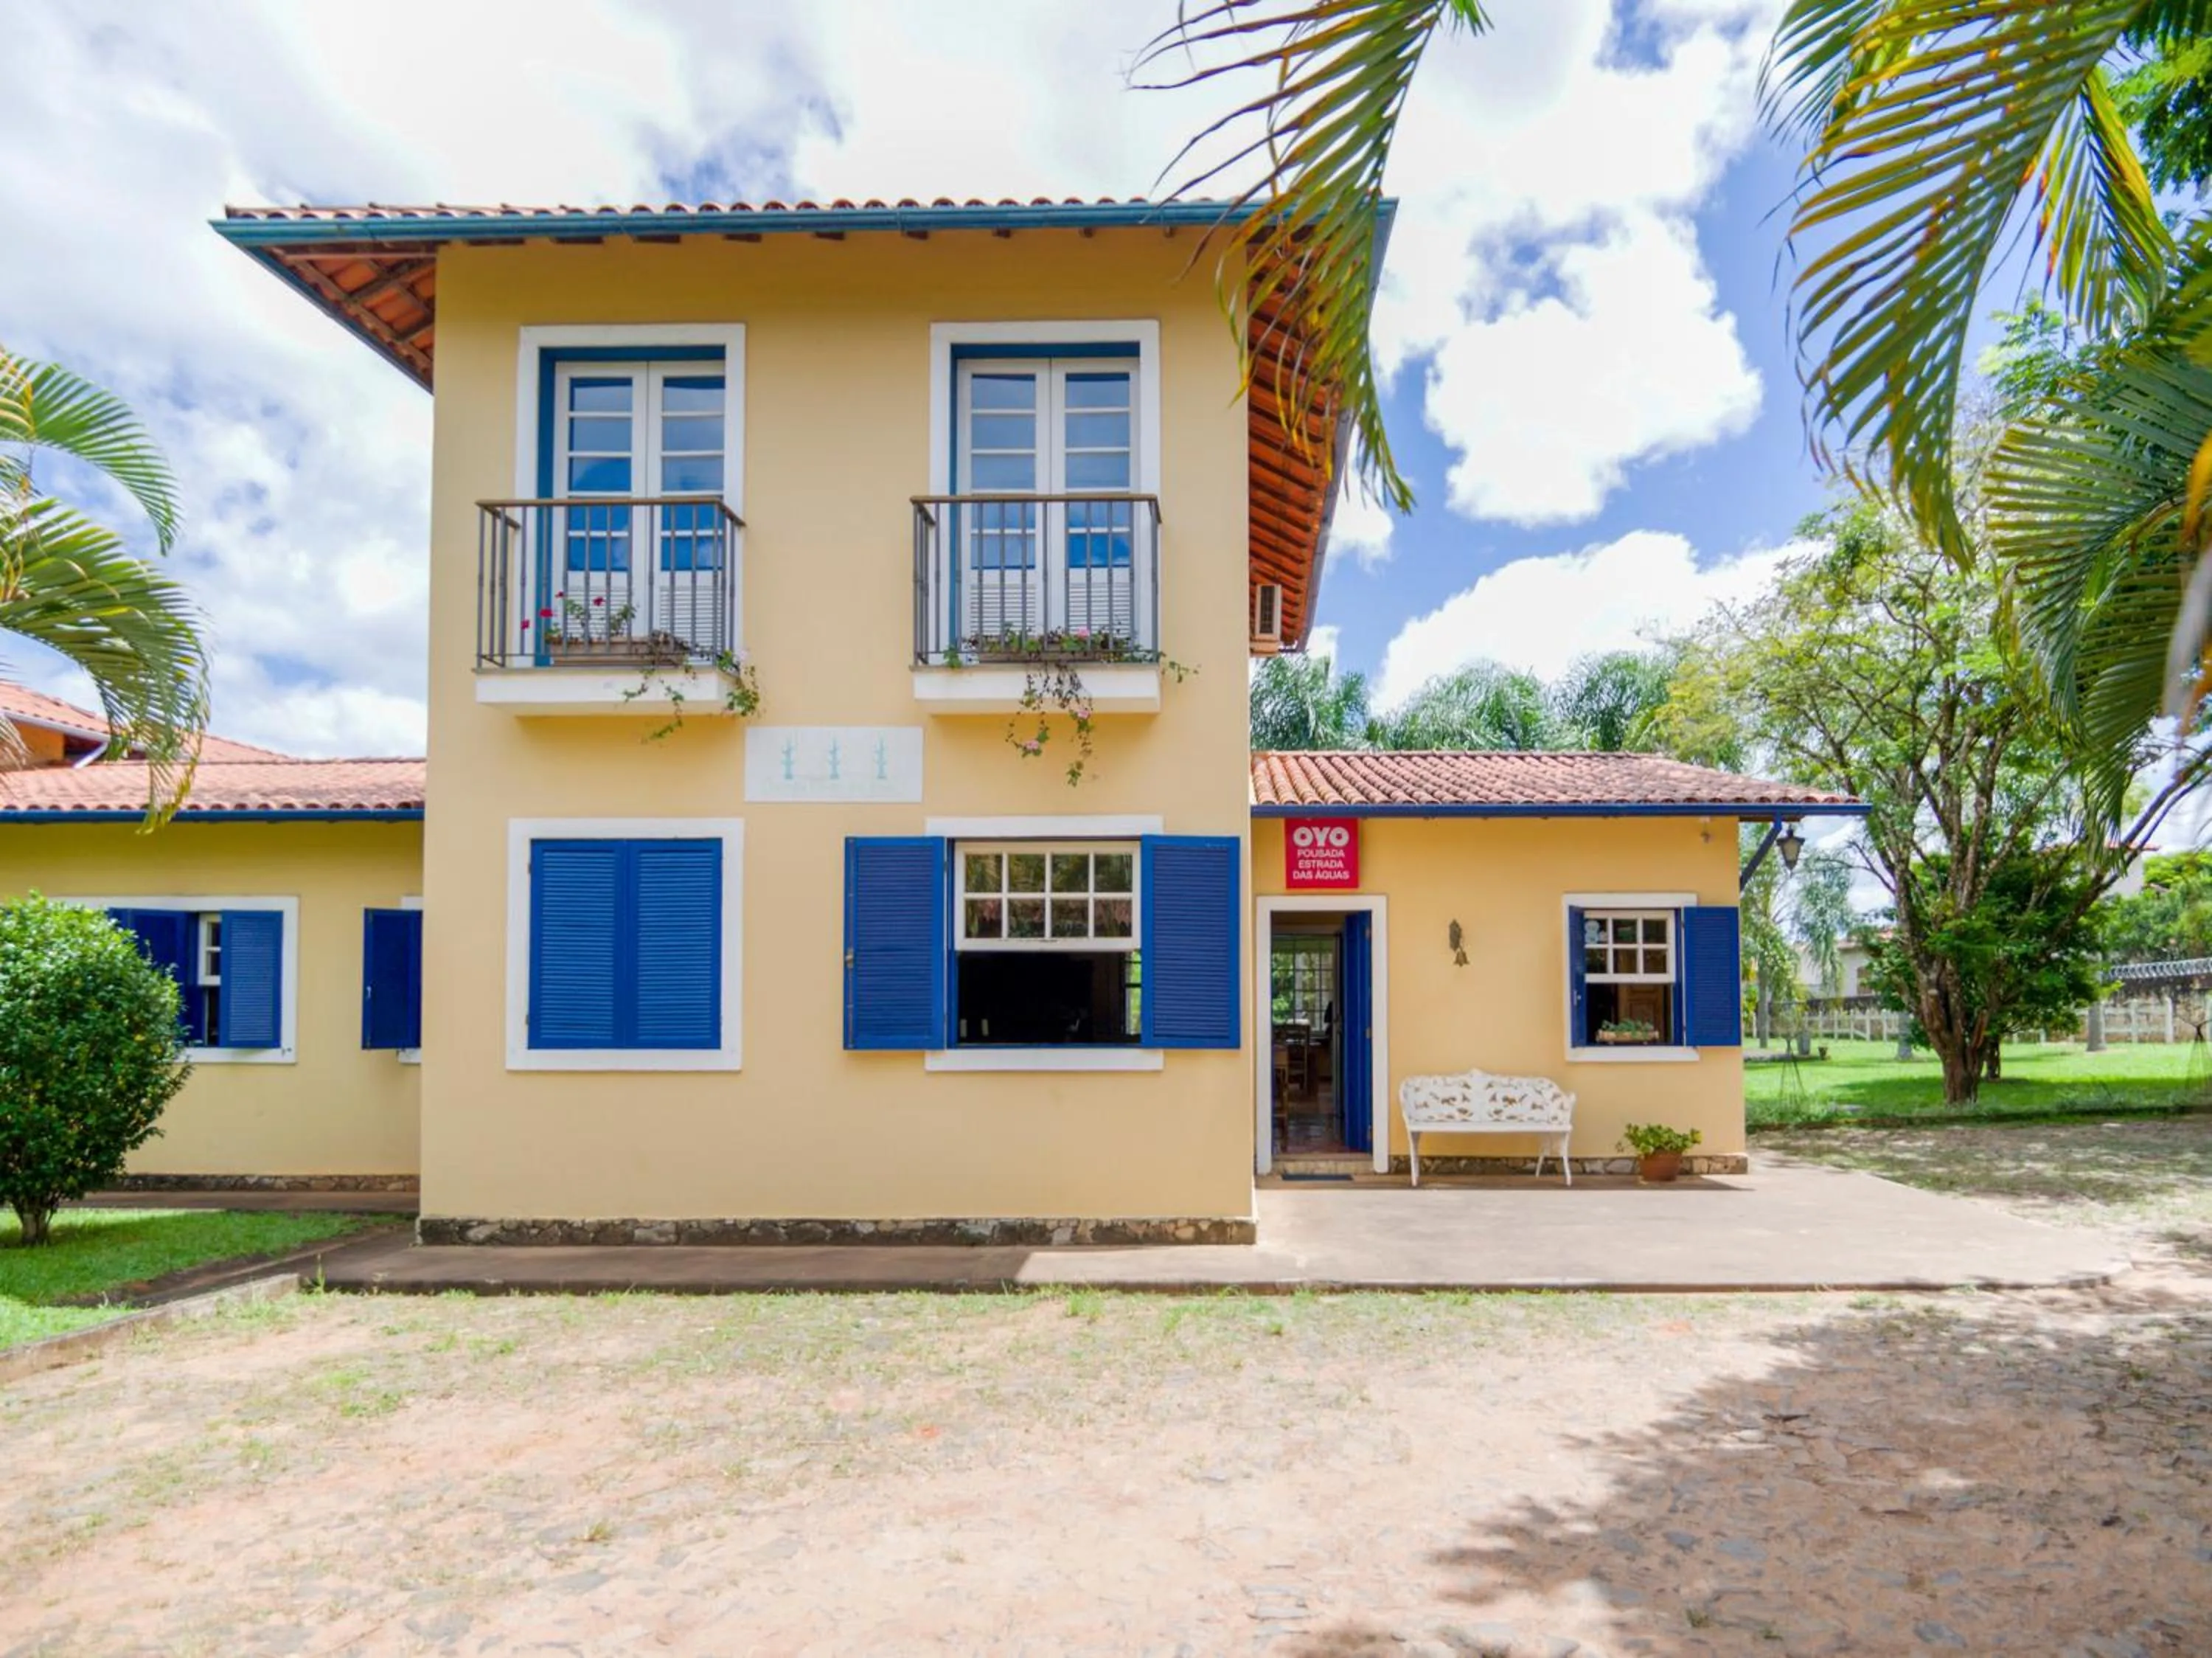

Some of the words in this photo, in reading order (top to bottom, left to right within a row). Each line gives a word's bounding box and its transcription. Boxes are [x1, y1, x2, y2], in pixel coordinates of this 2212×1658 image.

[1293, 826, 1349, 847] OYO
[1297, 849, 1345, 858] POUSADA
[1298, 859, 1344, 869] ESTRADA
[1293, 870, 1313, 880] DAS
